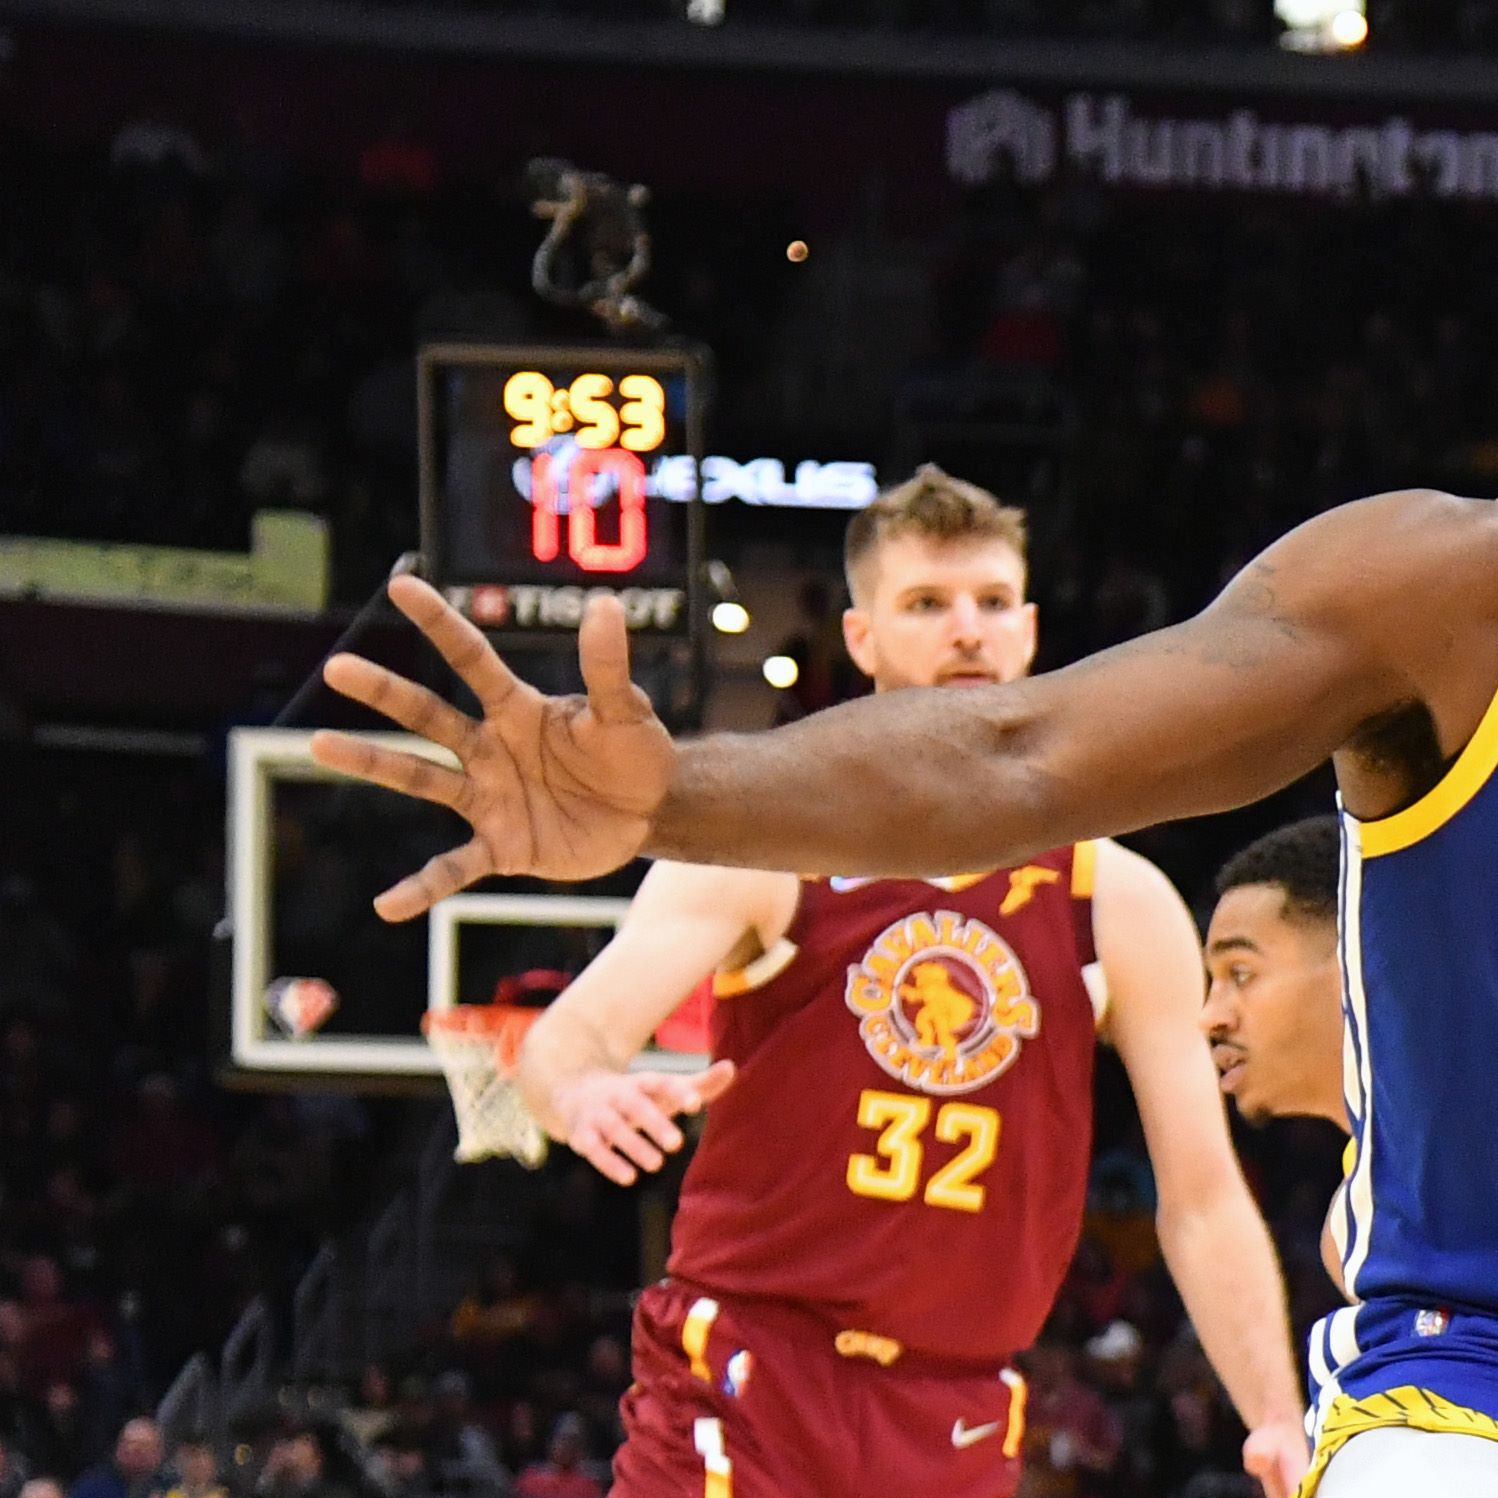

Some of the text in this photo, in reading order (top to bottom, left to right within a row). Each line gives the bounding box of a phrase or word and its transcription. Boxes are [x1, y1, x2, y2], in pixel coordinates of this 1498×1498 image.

[503, 370, 666, 452] 9:53
[530, 446, 648, 573] 10
[511, 584, 686, 630] TISOT
[845, 1088, 1001, 1214] 32
